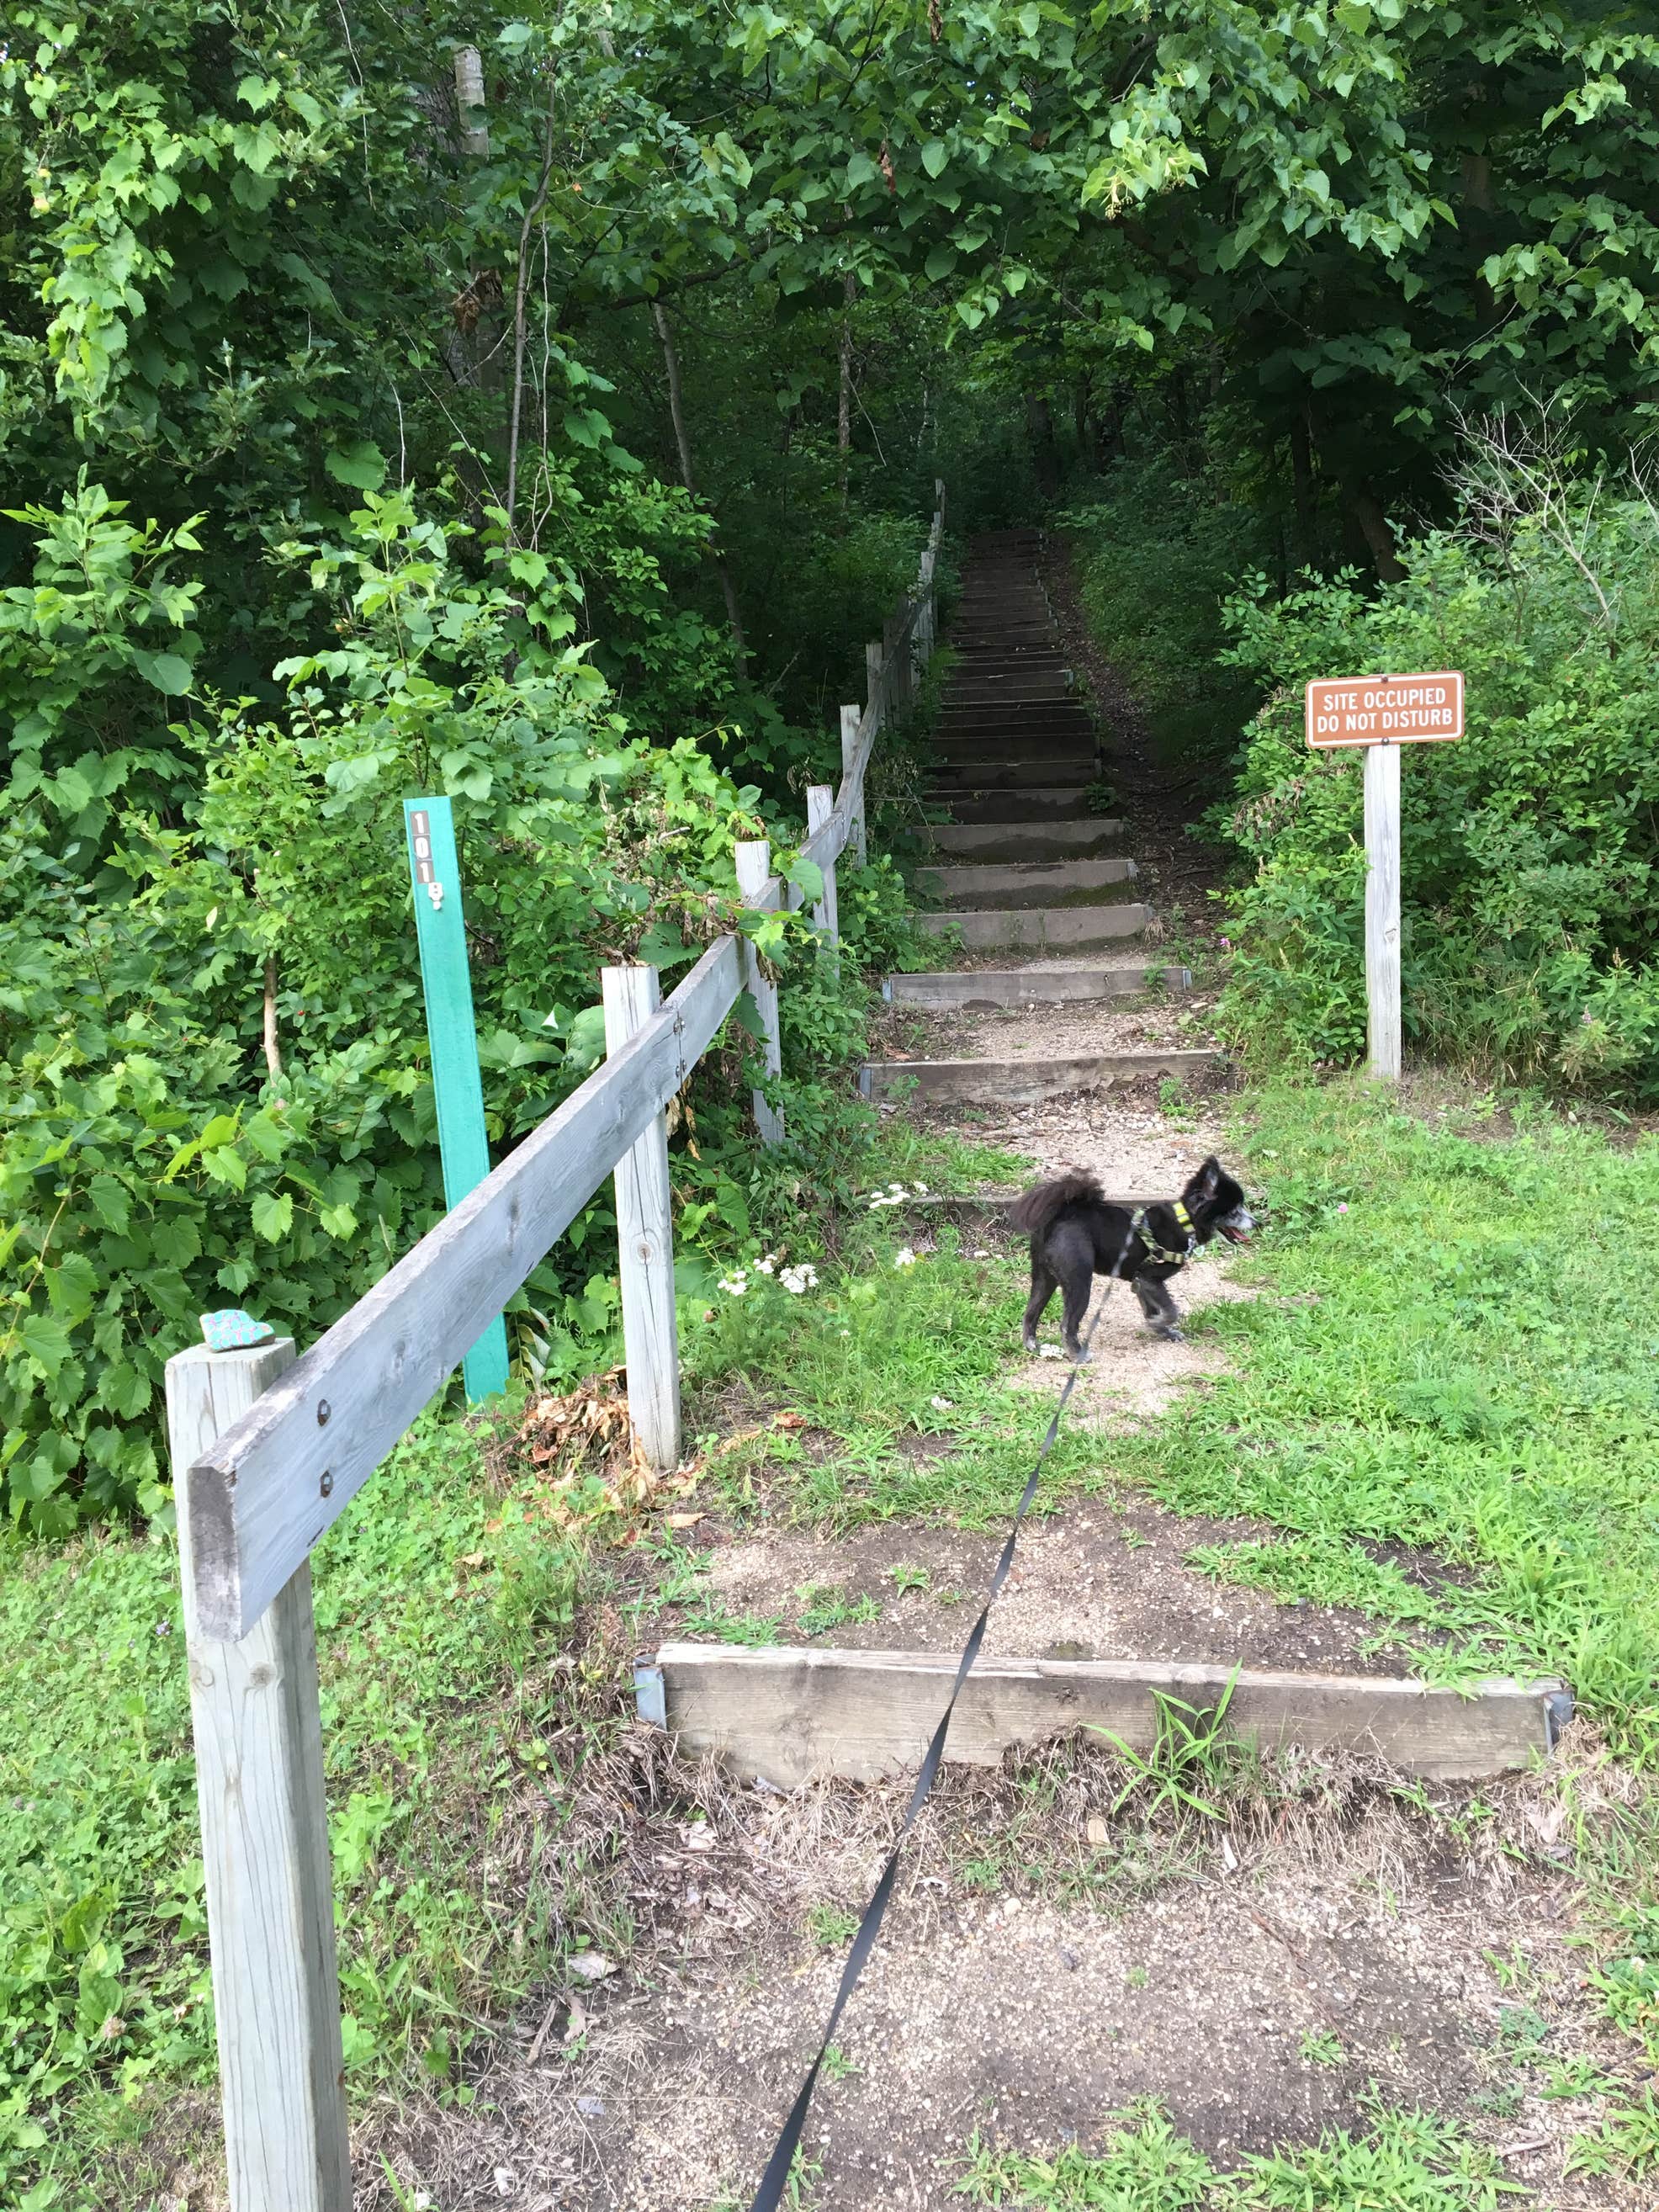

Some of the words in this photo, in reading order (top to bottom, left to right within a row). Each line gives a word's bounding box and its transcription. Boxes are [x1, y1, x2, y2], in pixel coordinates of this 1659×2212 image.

[1323, 692, 1358, 711] SITE
[1364, 687, 1445, 708] OCCUPIED
[1317, 715, 1339, 733] DO
[1346, 712, 1377, 731] NOT
[1382, 708, 1452, 729] DISTURB
[414, 813, 430, 883] 101
